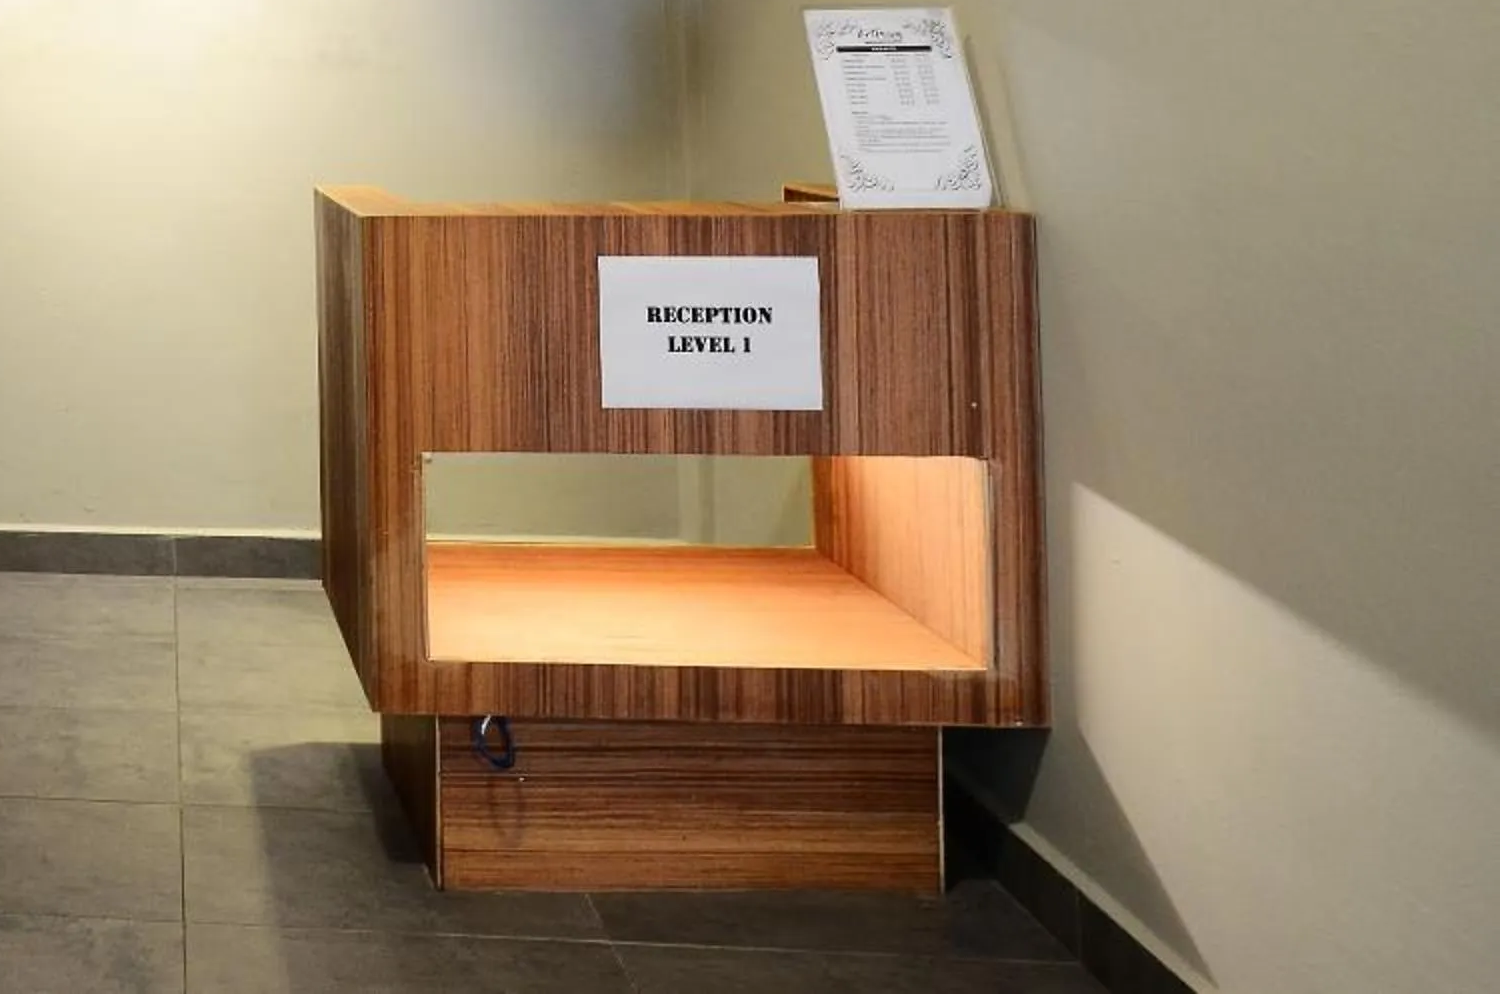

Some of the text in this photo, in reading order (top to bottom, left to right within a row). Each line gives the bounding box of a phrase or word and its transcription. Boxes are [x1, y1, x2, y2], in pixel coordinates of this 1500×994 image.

[646, 306, 773, 324] RECEPTION
[667, 336, 751, 353] LEVEL 1
